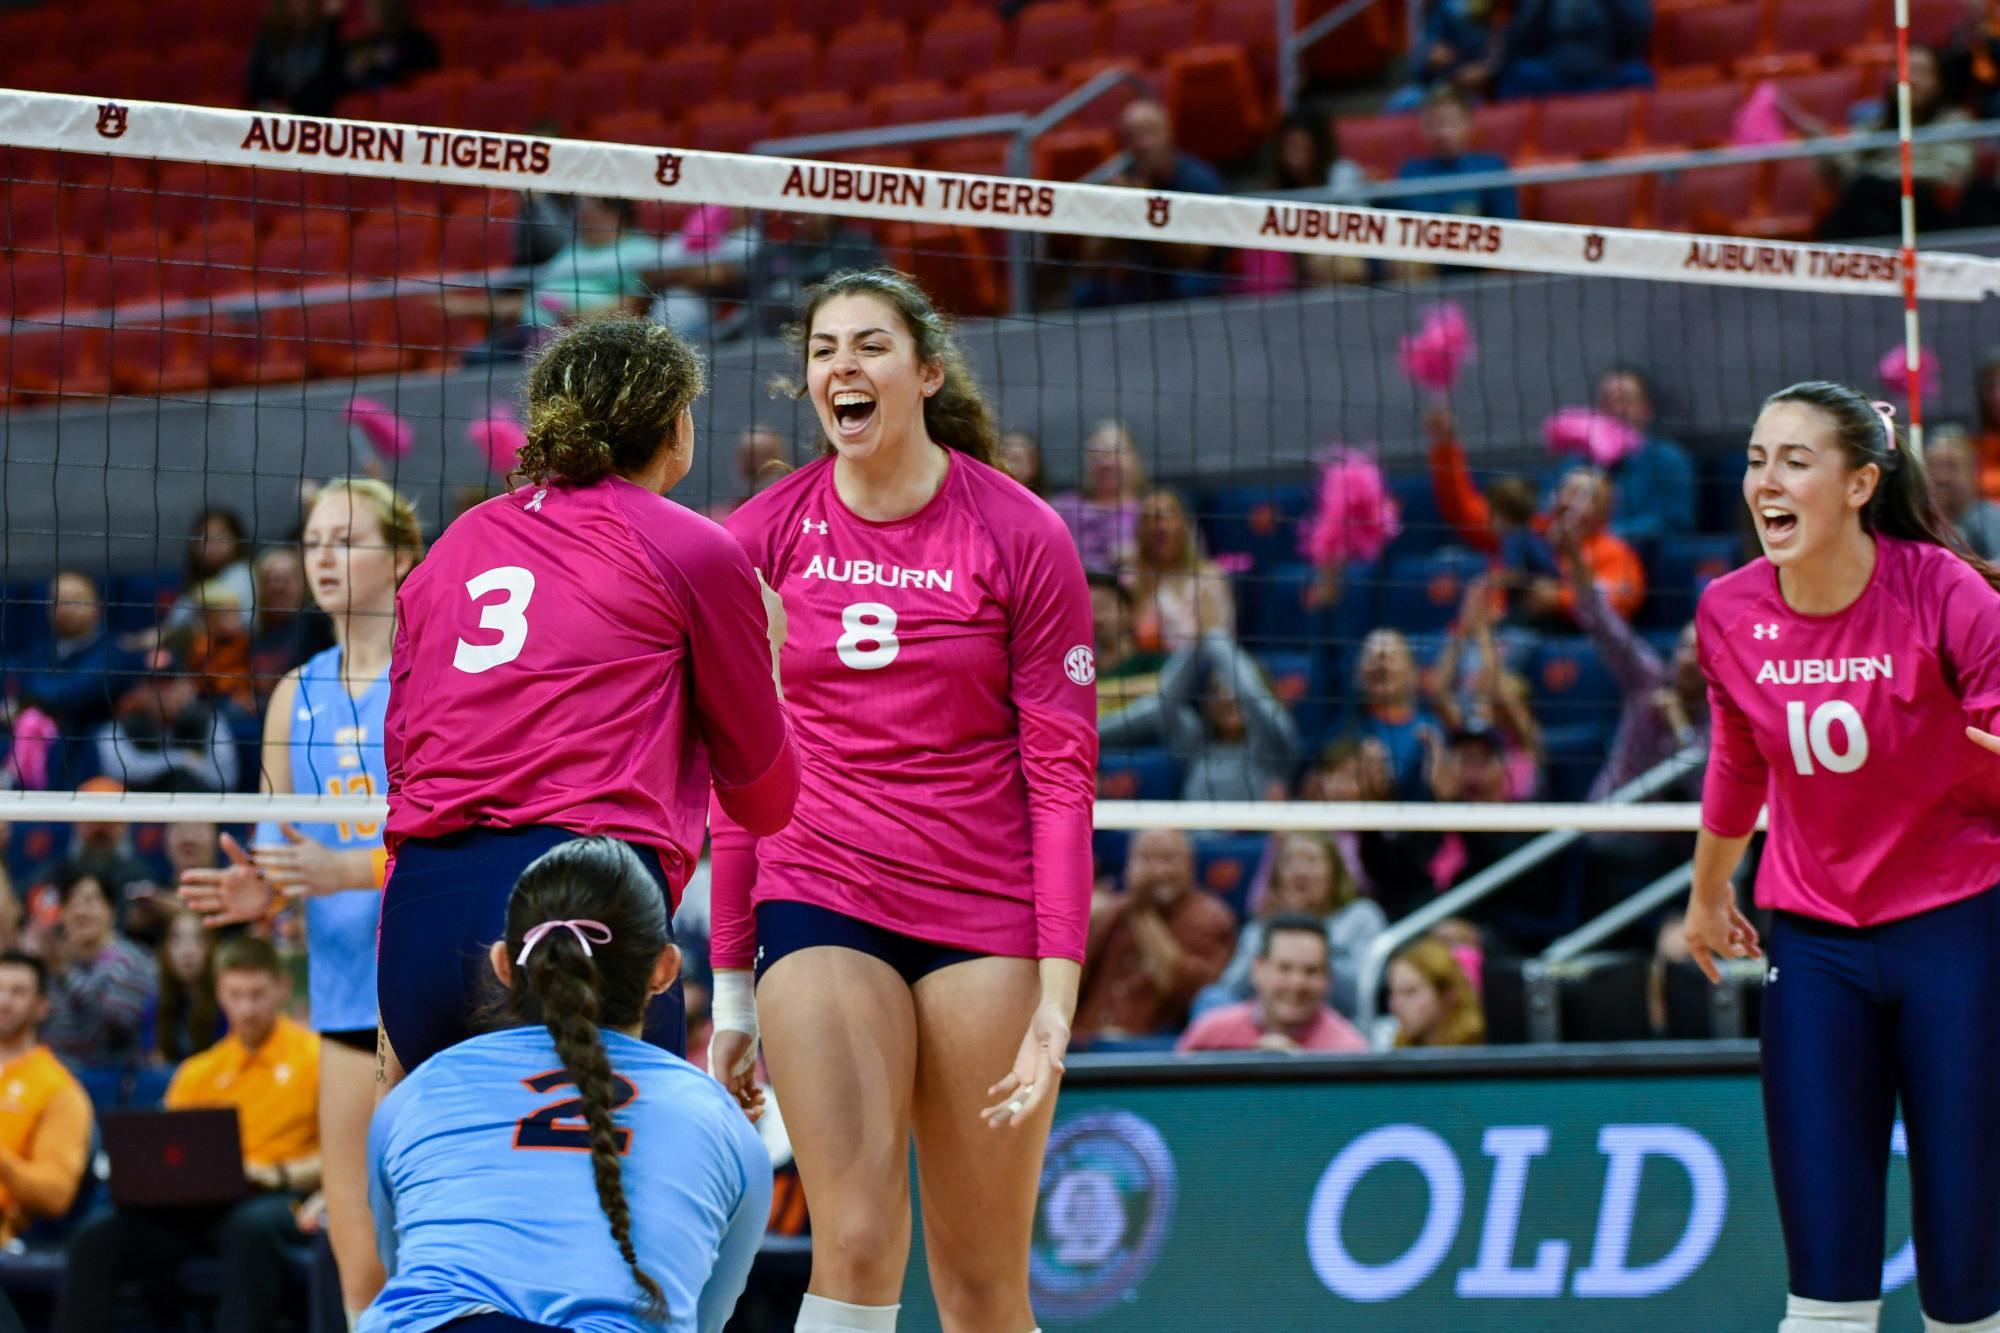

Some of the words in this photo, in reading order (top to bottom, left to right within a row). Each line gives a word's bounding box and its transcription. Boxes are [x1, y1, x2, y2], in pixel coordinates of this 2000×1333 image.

[241, 117, 404, 164] AUBURN
[416, 130, 552, 175] TIGERS
[782, 164, 926, 207] AUBURN
[937, 178, 1055, 218] TIGERS
[1259, 206, 1386, 245] AUBURN
[1398, 217, 1502, 254] TIGERS
[1684, 241, 1797, 275] AUBURN
[1808, 250, 1900, 282] TIGERS
[802, 553, 954, 593] AUBURN
[452, 565, 536, 674] 3
[835, 602, 900, 670] 8
[1065, 646, 1095, 684] SEC
[1756, 654, 1894, 685] AUBURN
[1786, 700, 1870, 776] 10
[511, 1068, 640, 1156] 2
[1305, 1123, 1728, 1302] OLD
